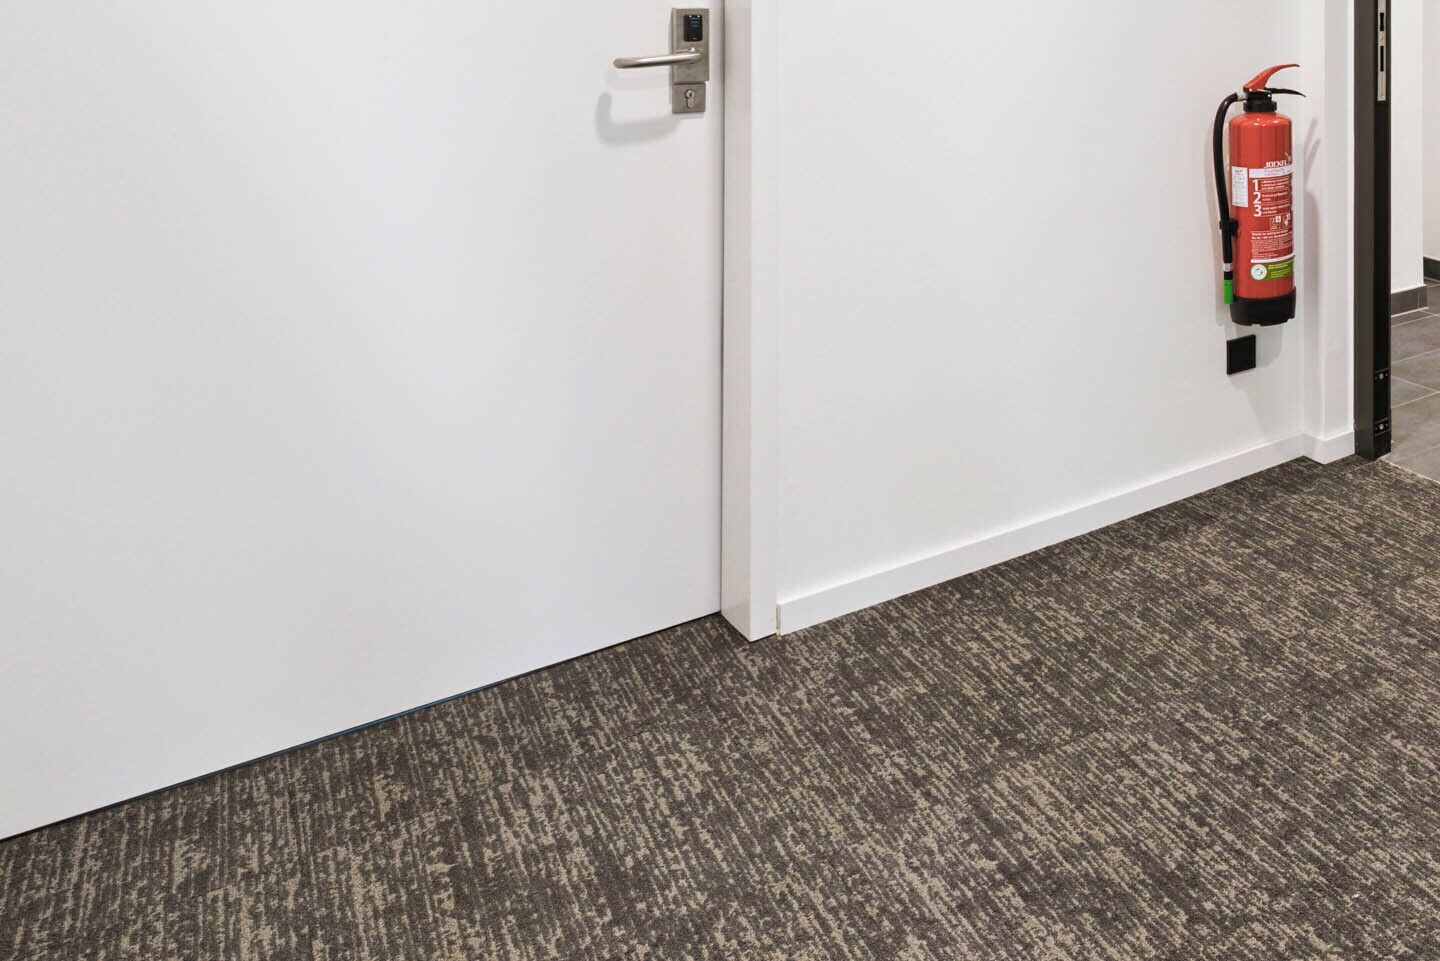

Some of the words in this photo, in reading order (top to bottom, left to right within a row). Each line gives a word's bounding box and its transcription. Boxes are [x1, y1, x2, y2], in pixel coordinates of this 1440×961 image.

[1252, 179, 1260, 192] 1
[1252, 192, 1262, 205] 2
[1253, 204, 1262, 217] 3
